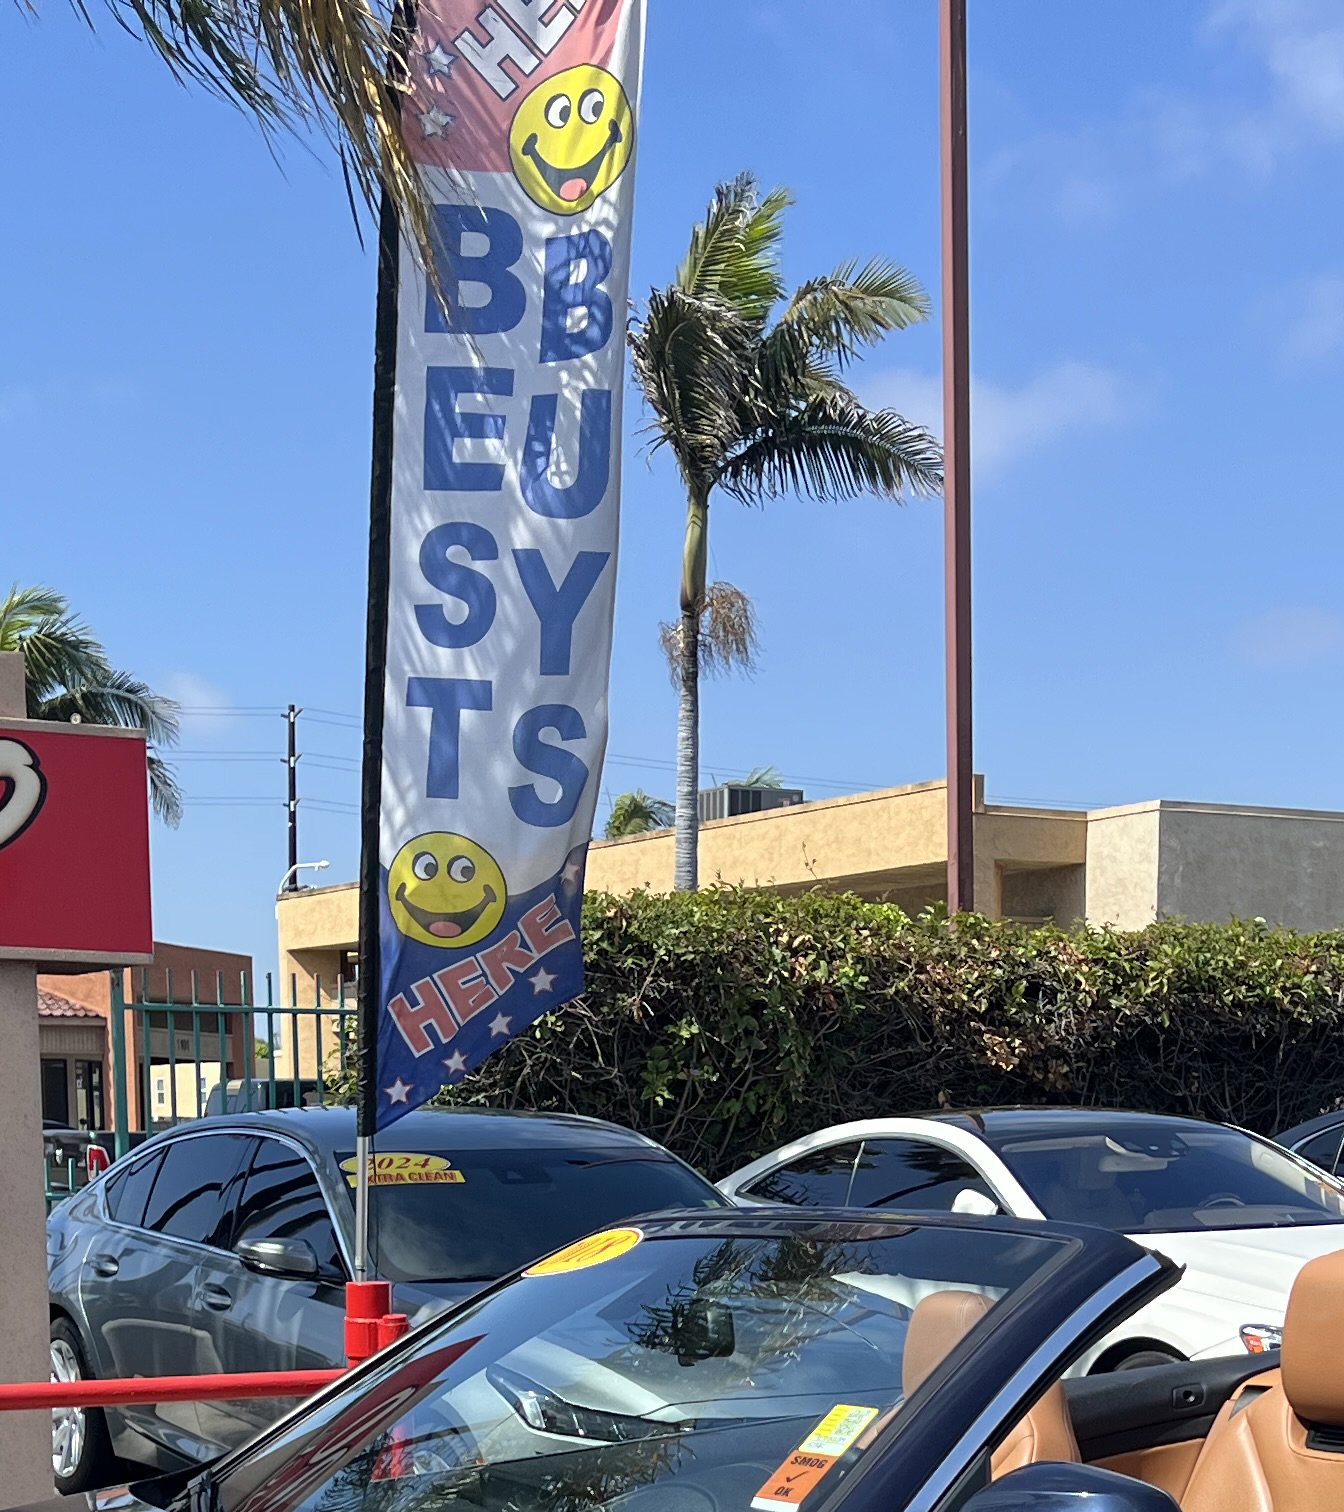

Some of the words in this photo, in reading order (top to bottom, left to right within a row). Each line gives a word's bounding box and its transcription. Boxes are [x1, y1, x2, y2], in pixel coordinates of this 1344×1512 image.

[452, 0, 586, 101] HE
[387, 893, 576, 1060] HERE
[367, 1156, 432, 1170] 2024
[367, 1172, 405, 1184] XTRA
[408, 1171, 456, 1183] CLEAN
[790, 1455, 829, 1469] SMOG
[773, 1485, 794, 1497] OK
